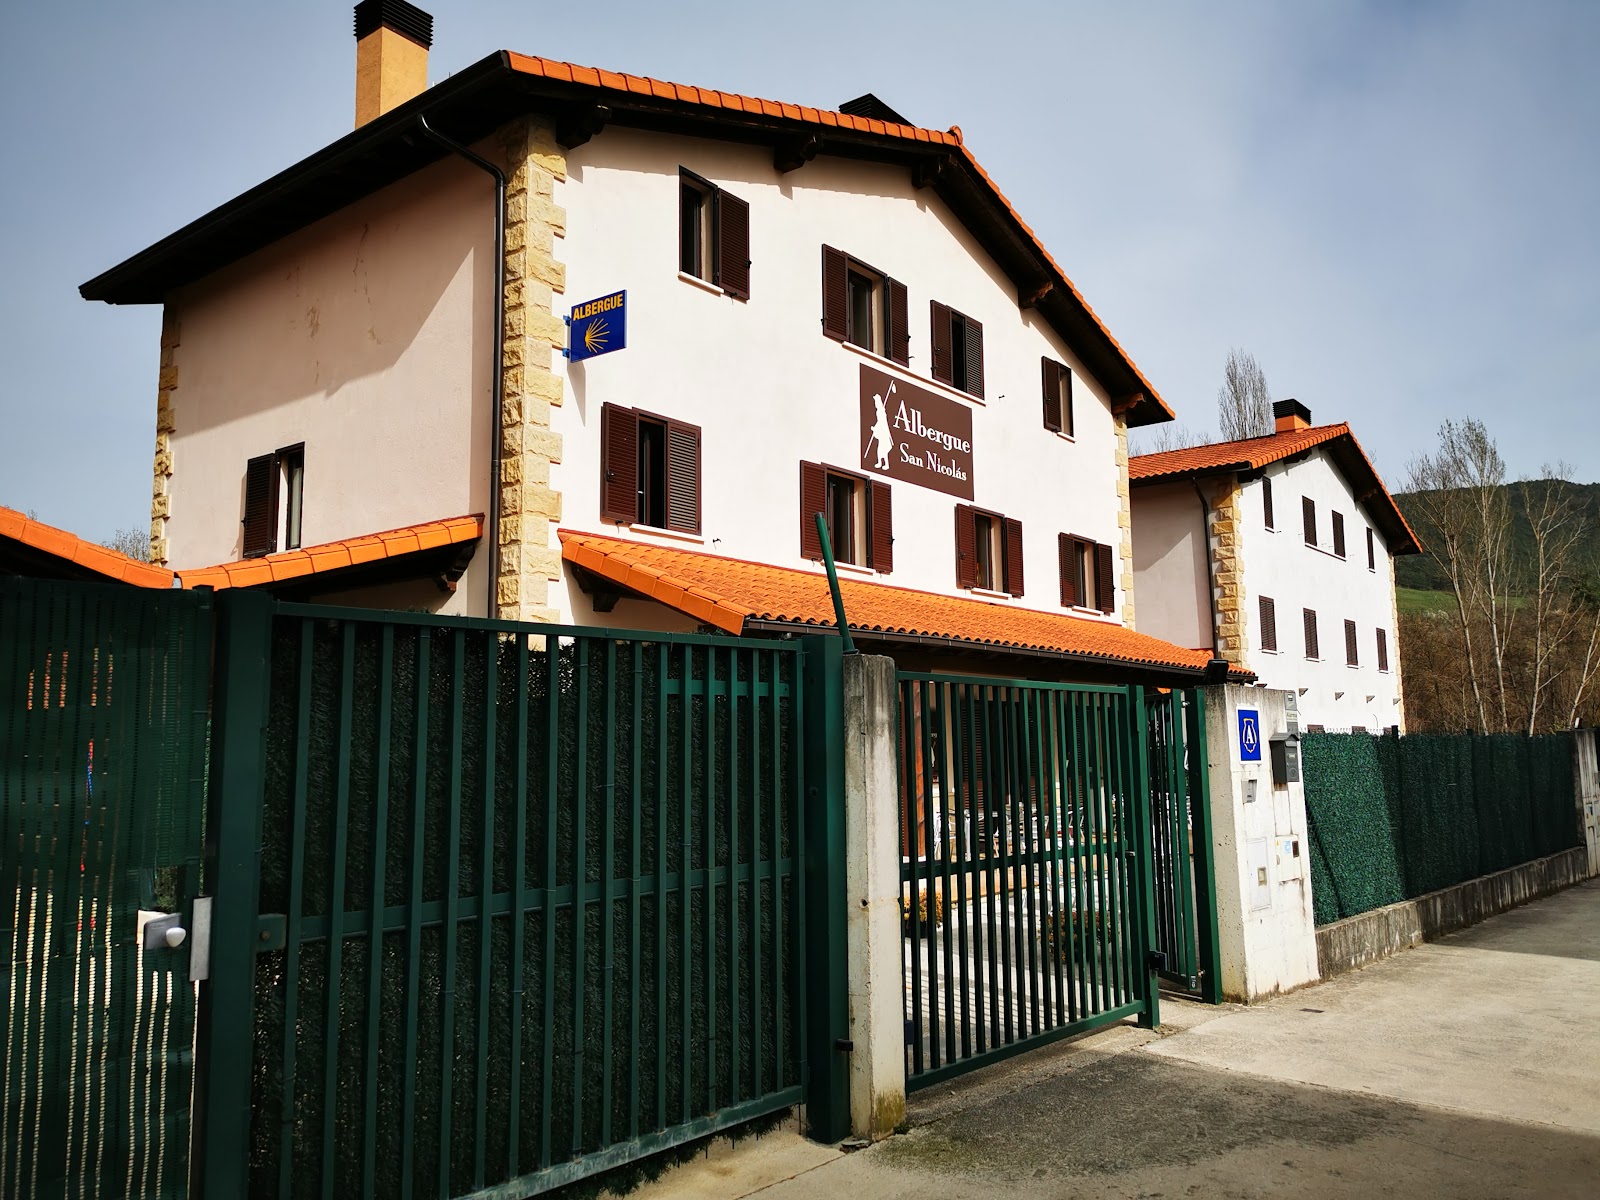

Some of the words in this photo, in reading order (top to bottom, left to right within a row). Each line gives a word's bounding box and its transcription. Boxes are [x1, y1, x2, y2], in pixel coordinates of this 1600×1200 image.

[573, 293, 623, 321] ALBERGUE
[893, 399, 971, 453] Albergue
[899, 442, 924, 467] San
[926, 450, 967, 481] Nicolás
[1246, 725, 1254, 744] A
